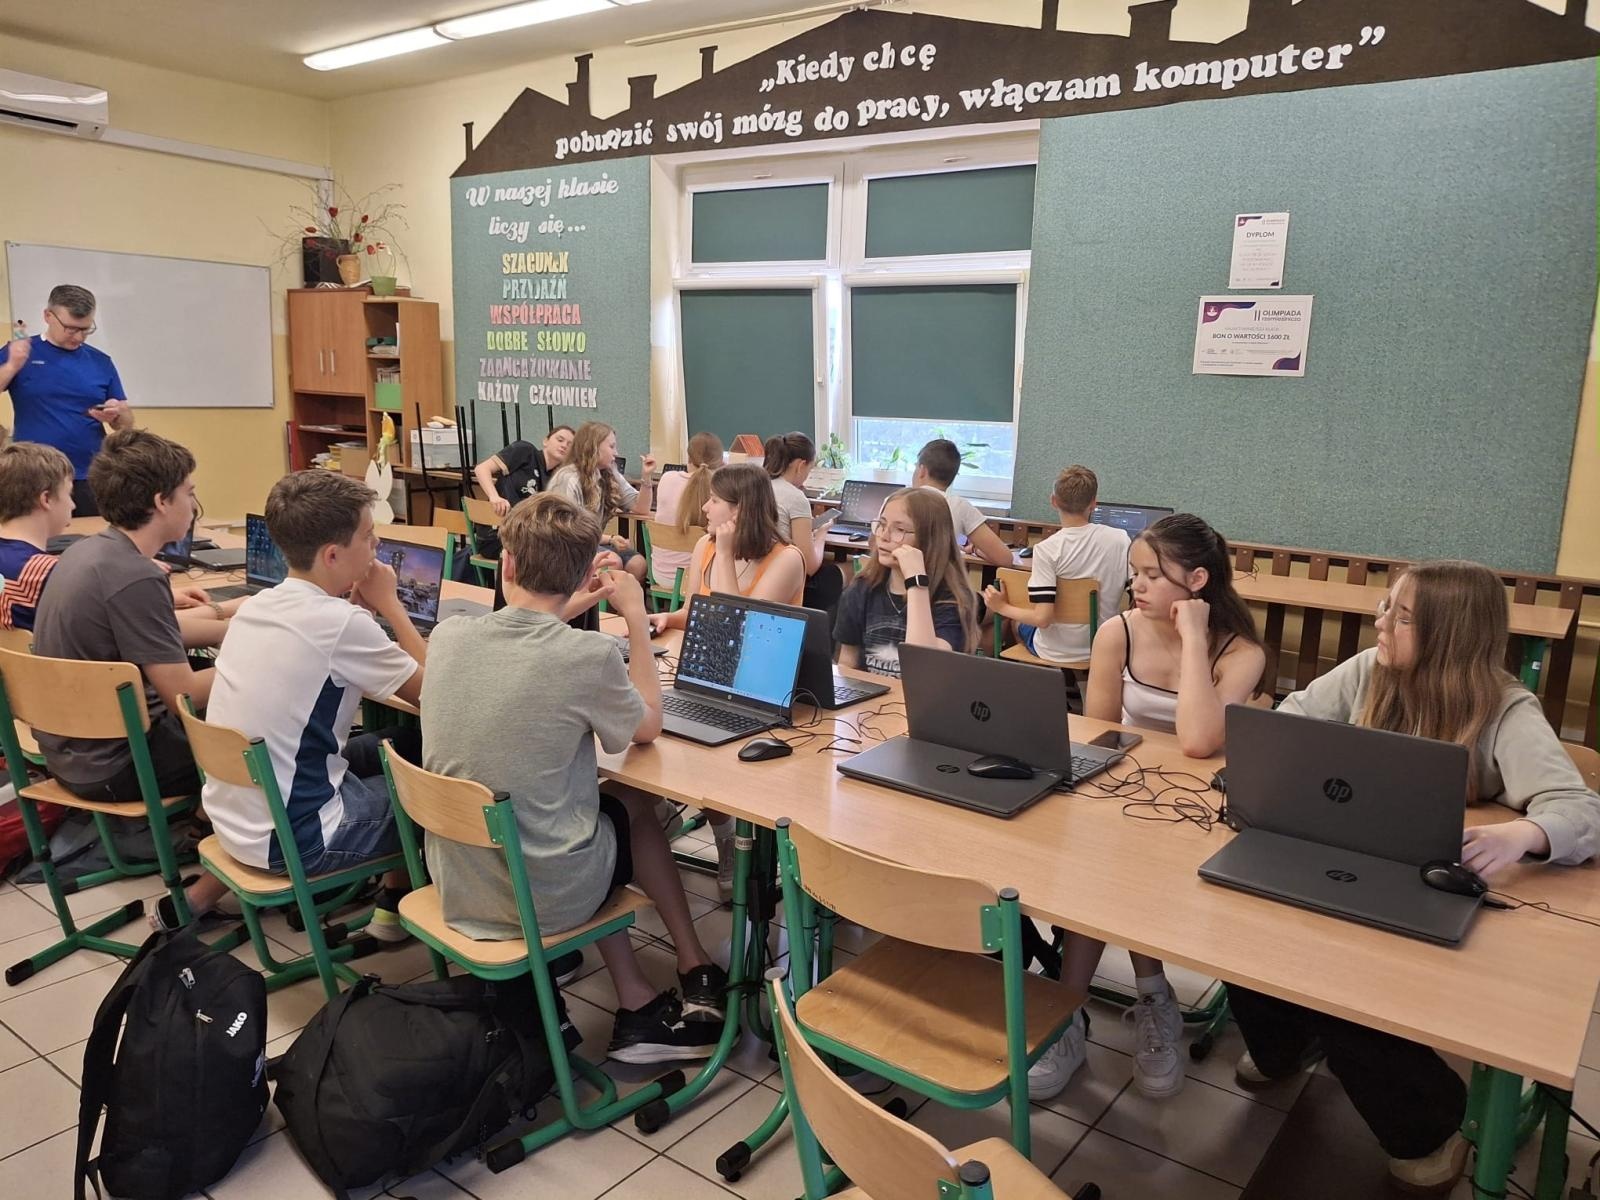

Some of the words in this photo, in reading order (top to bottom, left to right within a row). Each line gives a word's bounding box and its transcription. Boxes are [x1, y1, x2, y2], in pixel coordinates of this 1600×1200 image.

[759, 51, 855, 93] „Kiedy
[863, 41, 937, 71] chcę
[555, 119, 653, 159] pobudzić
[666, 111, 723, 143] swój
[732, 103, 803, 137] mózg
[814, 106, 850, 132] do
[856, 94, 950, 128] pracy,
[959, 77, 1121, 112] włączam
[1134, 26, 1386, 91] komputer”
[466, 185, 490, 207] W
[494, 178, 552, 207] naszej
[558, 172, 619, 199] klasie
[489, 215, 530, 243] liczy
[502, 274, 567, 299] PRZYJAŹŃ
[490, 301, 581, 325] WSPÓŁPRACA
[487, 331, 528, 351] DOBRE
[537, 331, 586, 352] SŁOWO
[1233, 332, 1266, 340] WARTOŚCI
[480, 353, 592, 380] ZAANGAŻOWANIE
[478, 380, 519, 403] KAŻDY
[529, 384, 597, 408] CZŁOWIEK
[970, 700, 992, 722] hp
[1323, 778, 1353, 803] hp
[225, 1012, 248, 1037] JAKO
